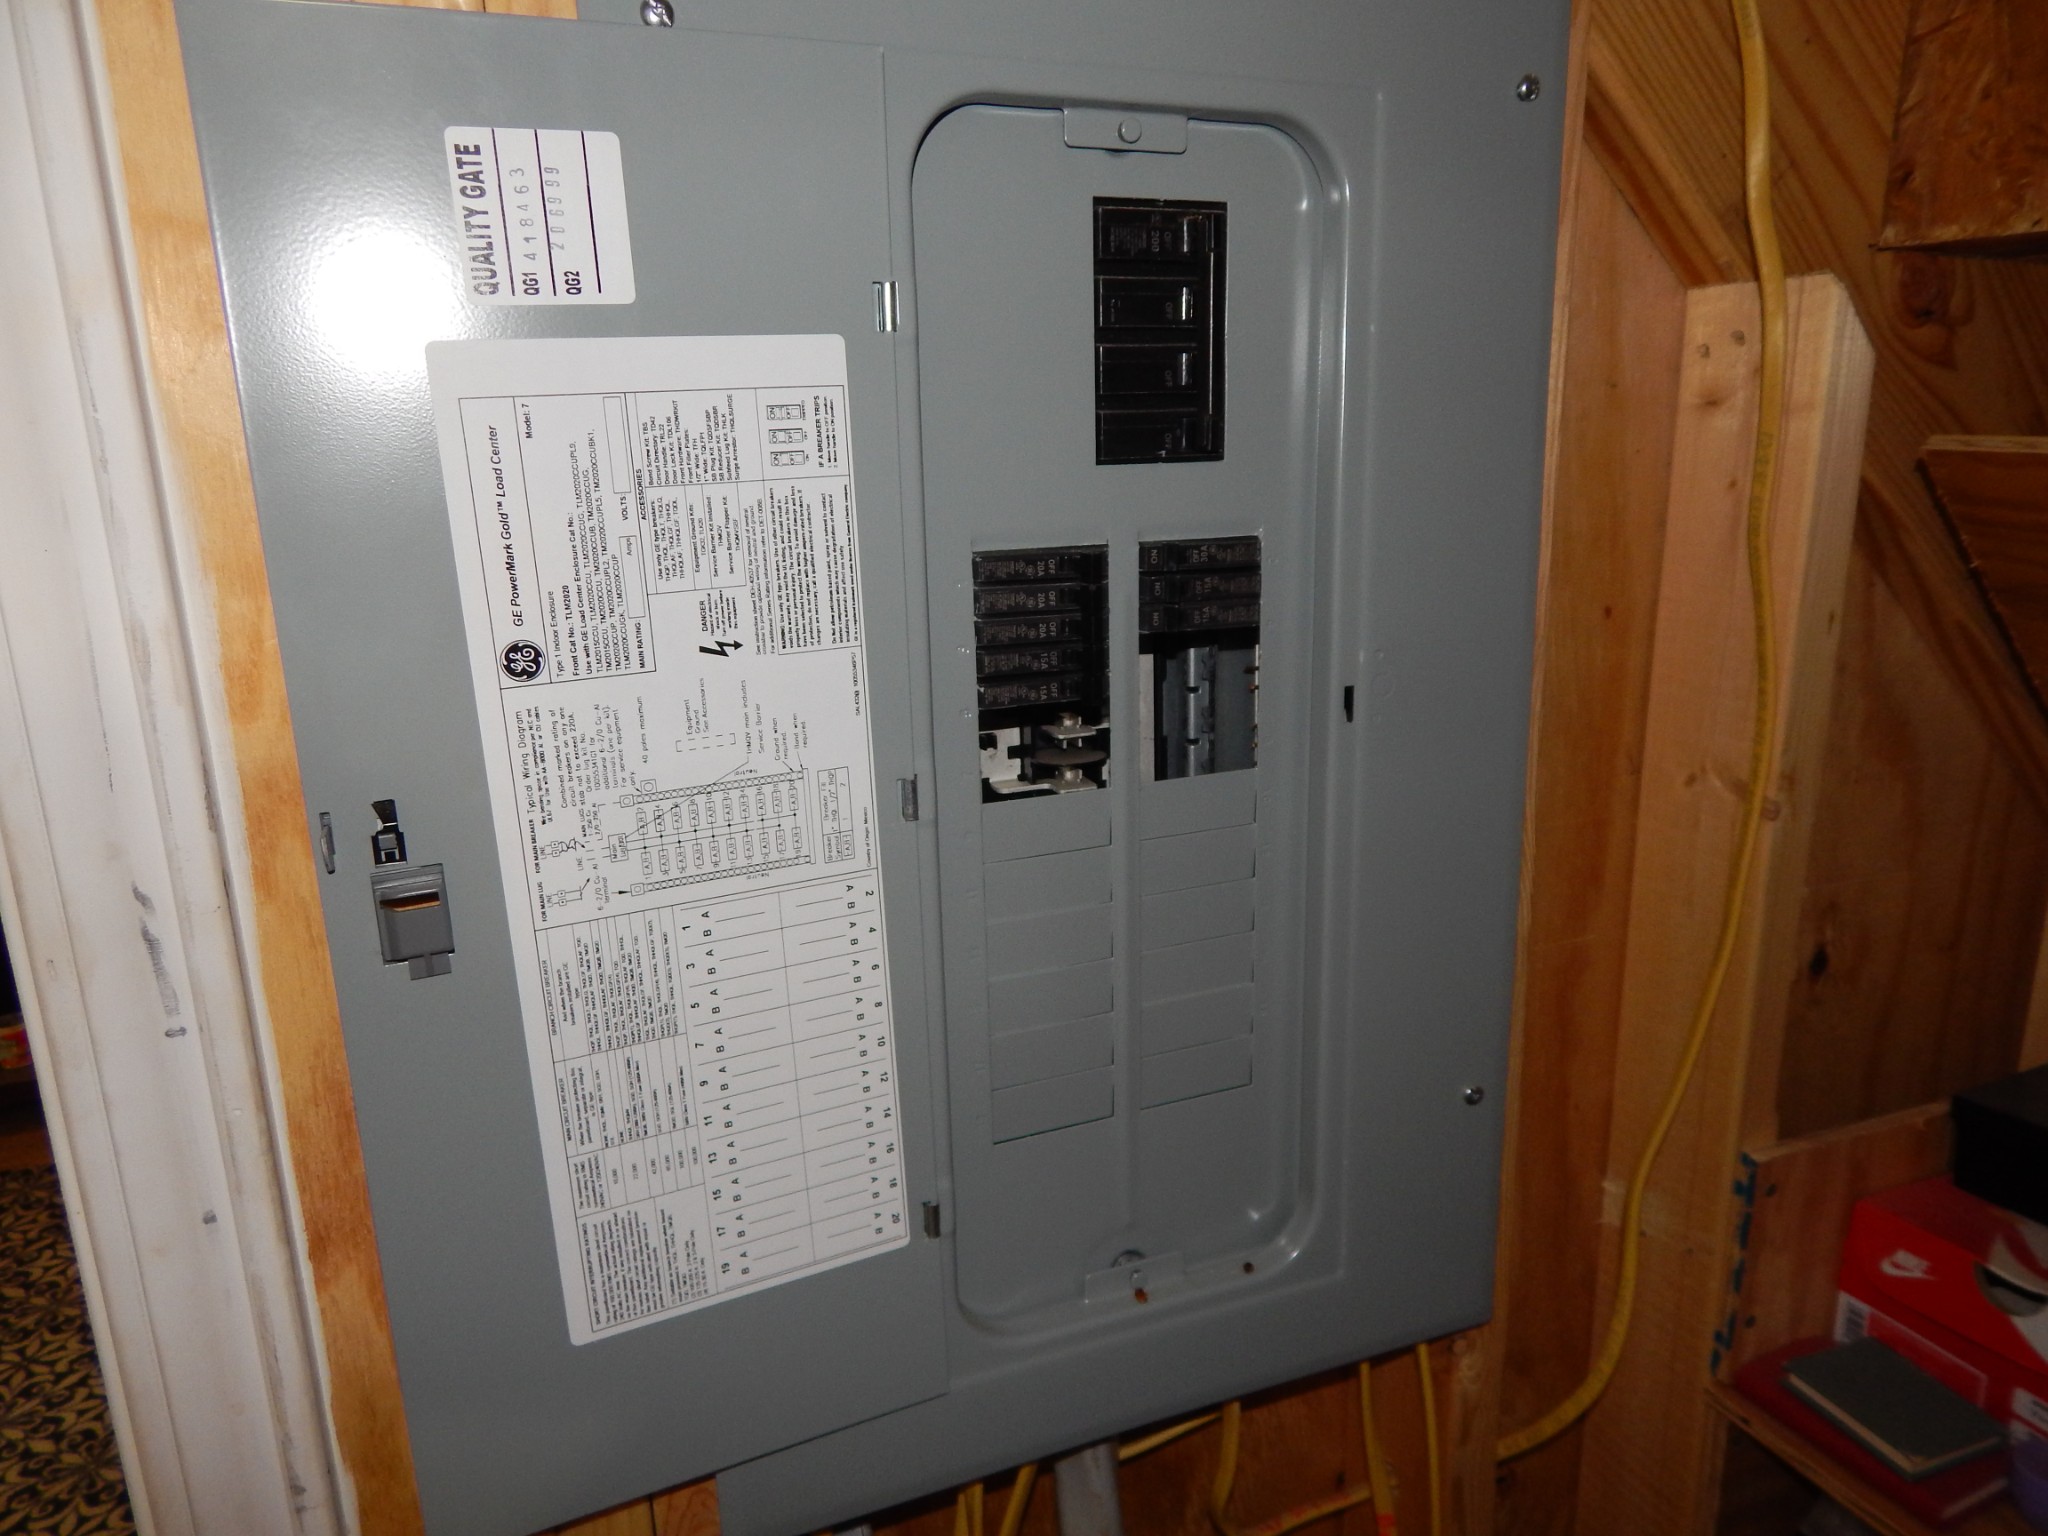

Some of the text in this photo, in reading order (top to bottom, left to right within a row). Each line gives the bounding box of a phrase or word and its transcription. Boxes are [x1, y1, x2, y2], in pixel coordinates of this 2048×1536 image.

[454, 143, 500, 296] QUALITY GATE
[522, 272, 540, 295] QG1
[564, 270, 582, 295] QG2
[813, 395, 821, 417] TRIPS
[522, 410, 533, 439] Model:
[488, 425, 502, 465] Center
[814, 418, 824, 453] BREAKER
[491, 467, 506, 498] Load
[635, 468, 647, 521] ACCESSORIES
[619, 493, 629, 521] VOLTS:
[568, 529, 576, 543] Cat
[625, 537, 633, 556] Amps
[571, 543, 582, 583] Enclosure
[502, 542, 521, 607] PowerMark
[561, 584, 573, 621] TLM2020
[574, 583, 585, 608] Center
[511, 609, 524, 627] GE
[547, 590, 558, 628] Enclosure
[577, 609, 587, 628] Load
[698, 599, 709, 632] DANGER
[552, 628, 561, 652] Indoor
[580, 630, 589, 642] GE
[634, 619, 646, 669] MAIN RATING:
[568, 639, 577, 654] Cat
[582, 642, 591, 659] with
[556, 659, 566, 678] Type
[570, 654, 580, 677] Front
[585, 660, 593, 675] Use
[515, 710, 537, 814] Typical Wiring Diagram
[528, 818, 541, 874] FOR MAIN BREAKER
[536, 881, 548, 923] FOR MAIN LUG
[864, 889, 875, 897] 2
[868, 926, 877, 934] 4
[685, 962, 696, 970] 3
[870, 963, 880, 971] 6
[689, 1001, 700, 1009] 5
[873, 1000, 883, 1008] 8
[876, 1035, 886, 1048] 10
[698, 1079, 709, 1087] 9
[879, 1071, 889, 1083] 12
[702, 1115, 713, 1127] 11
[882, 1106, 892, 1119] 14
[707, 1151, 718, 1164] 13
[885, 1142, 895, 1154] 16
[888, 1177, 898, 1189] 18
[711, 1188, 722, 1201] 15
[890, 1212, 901, 1225] 20
[715, 1226, 726, 1237] 17
[720, 1262, 731, 1274] 19
